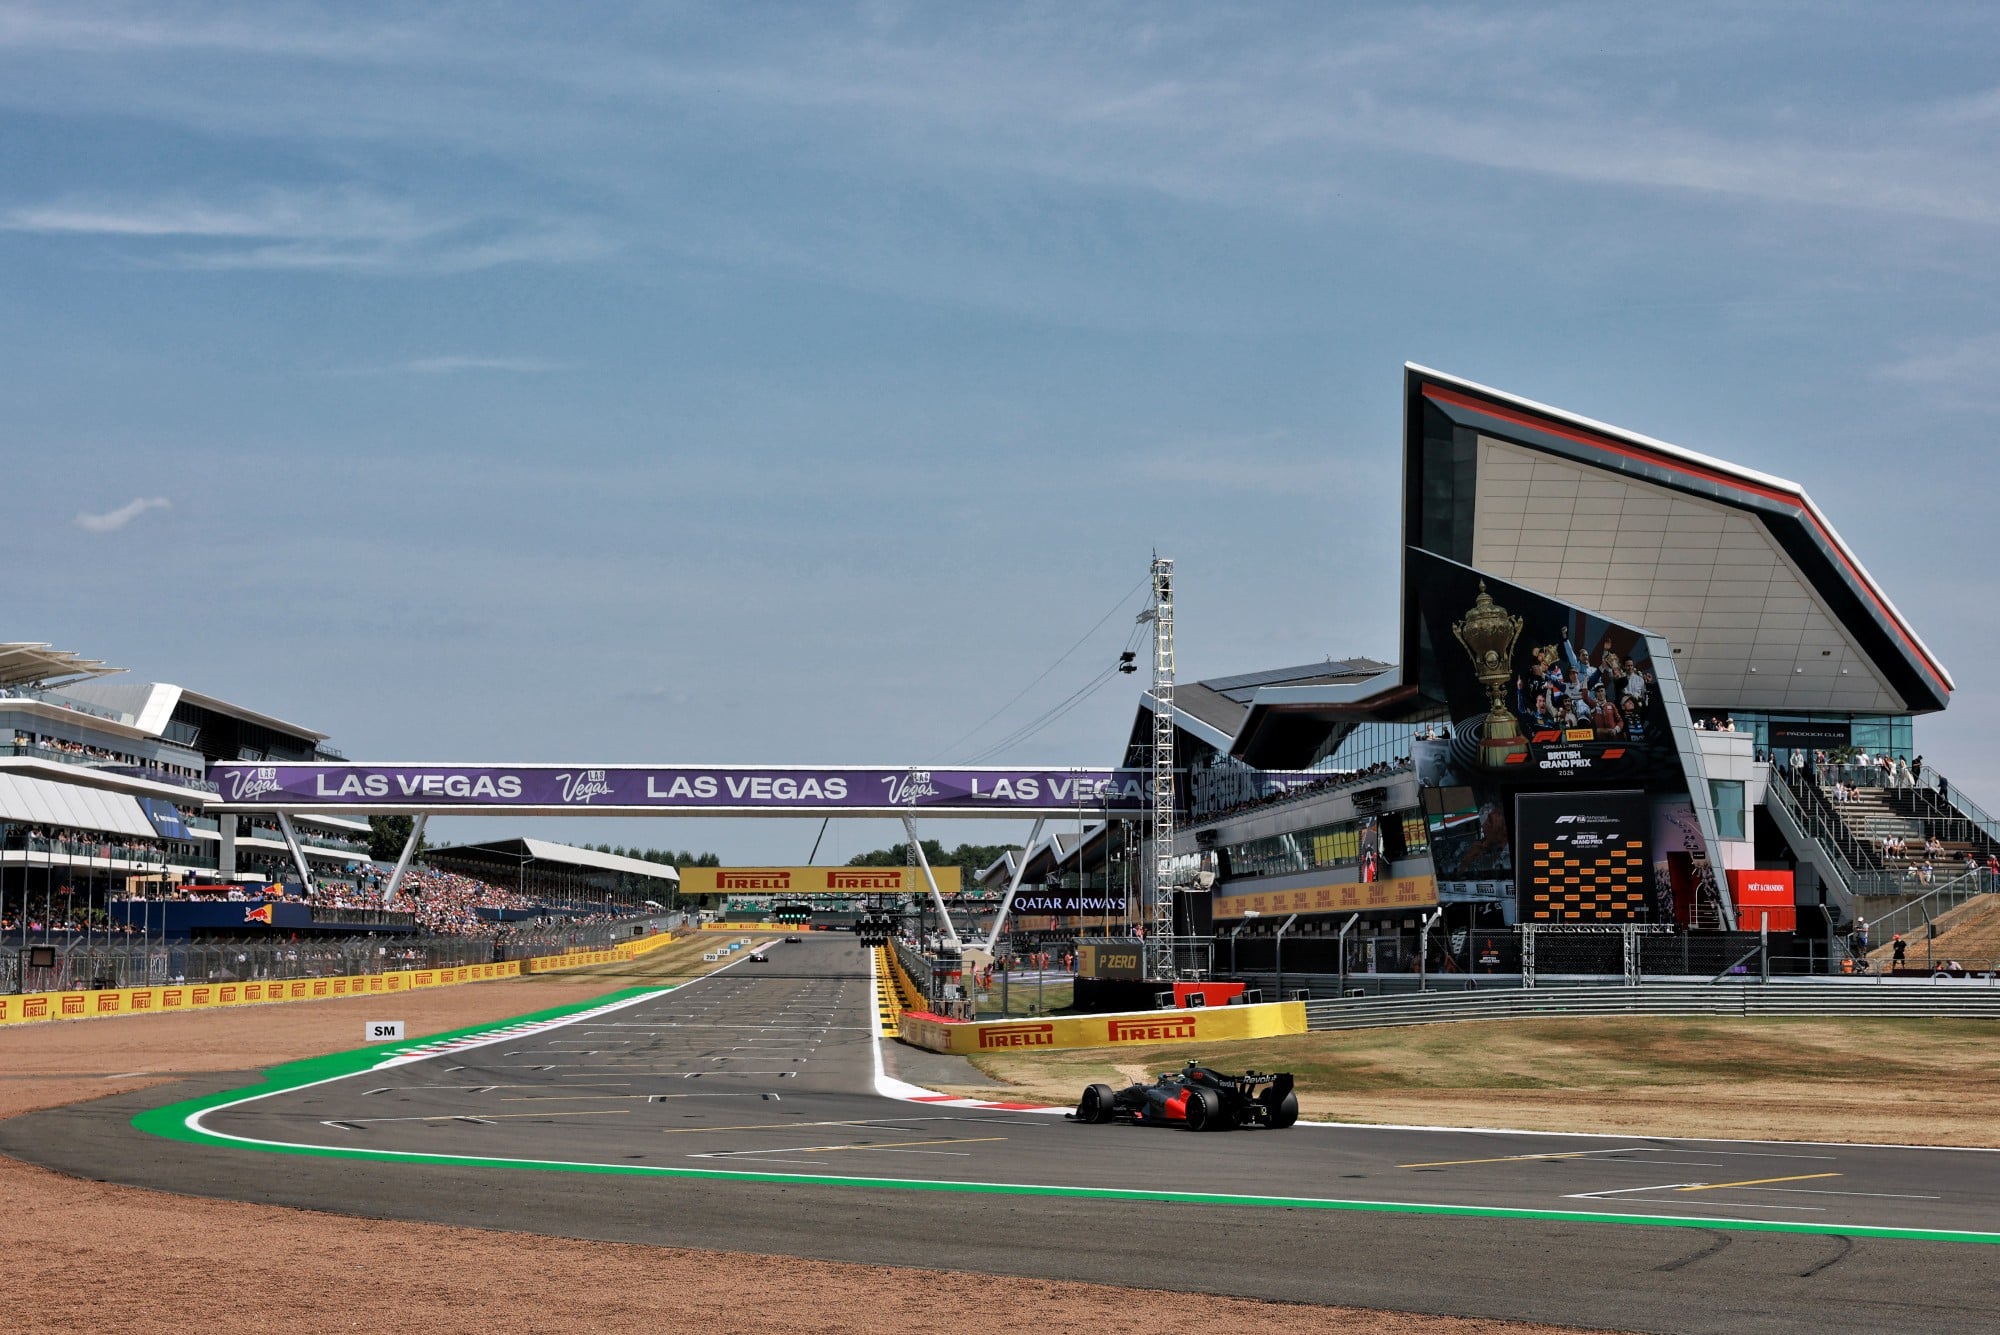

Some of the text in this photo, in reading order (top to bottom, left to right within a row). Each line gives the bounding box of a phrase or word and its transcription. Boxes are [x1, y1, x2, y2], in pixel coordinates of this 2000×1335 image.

[1539, 758, 1591, 769] GRAND PRIX
[1547, 751, 1581, 760] BRITISH
[259, 768, 275, 778] LAS
[589, 770, 604, 780] LAS
[225, 769, 283, 800] Vegas
[317, 773, 522, 798] LAS VEGAS
[555, 771, 614, 804] Vegas
[647, 776, 848, 800] LAS VEGAS
[881, 774, 939, 804] Vegas
[971, 778, 1040, 800] LAS
[716, 872, 791, 889] PIRELLI
[827, 872, 901, 889] PIRELLI
[1014, 897, 1126, 911] QATAR AIRWAYS
[1100, 955, 1106, 968] P
[1108, 955, 1137, 969] ZERO
[98, 994, 120, 1012] PIRELLI
[132, 992, 152, 1009] PIRELLI
[163, 990, 182, 1007] PIRELLI
[192, 988, 210, 1004] PIRELLI
[24, 998, 47, 1018] PIRELLI
[62, 996, 85, 1014] PIRELLI
[374, 1026, 395, 1036] SM
[978, 1023, 1054, 1048] PIRELLI
[1108, 1016, 1196, 1042] PIRELLI
[1243, 1075, 1277, 1083] Revolut
